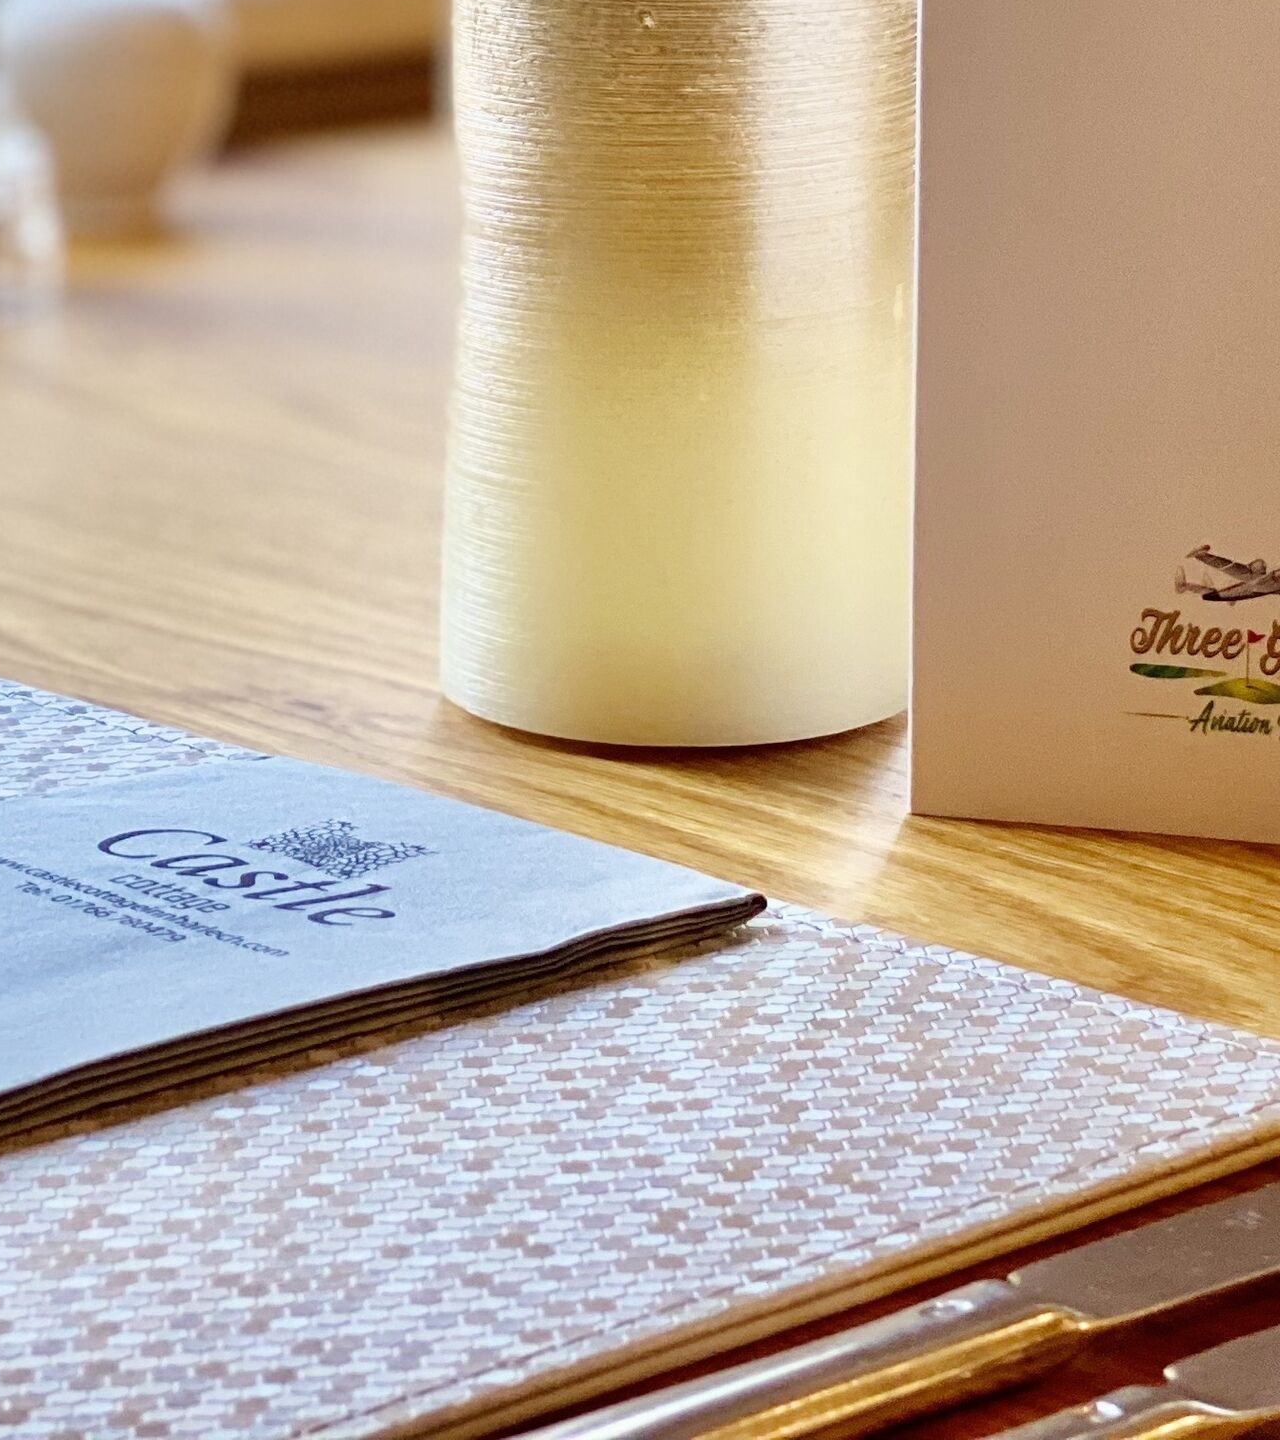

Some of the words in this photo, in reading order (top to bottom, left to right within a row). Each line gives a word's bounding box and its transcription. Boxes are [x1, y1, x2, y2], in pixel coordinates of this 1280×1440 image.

[1130, 608, 1246, 660] Three
[1188, 700, 1272, 736] Aviation
[96, 828, 396, 926] Castle
[108, 873, 231, 914] cottage
